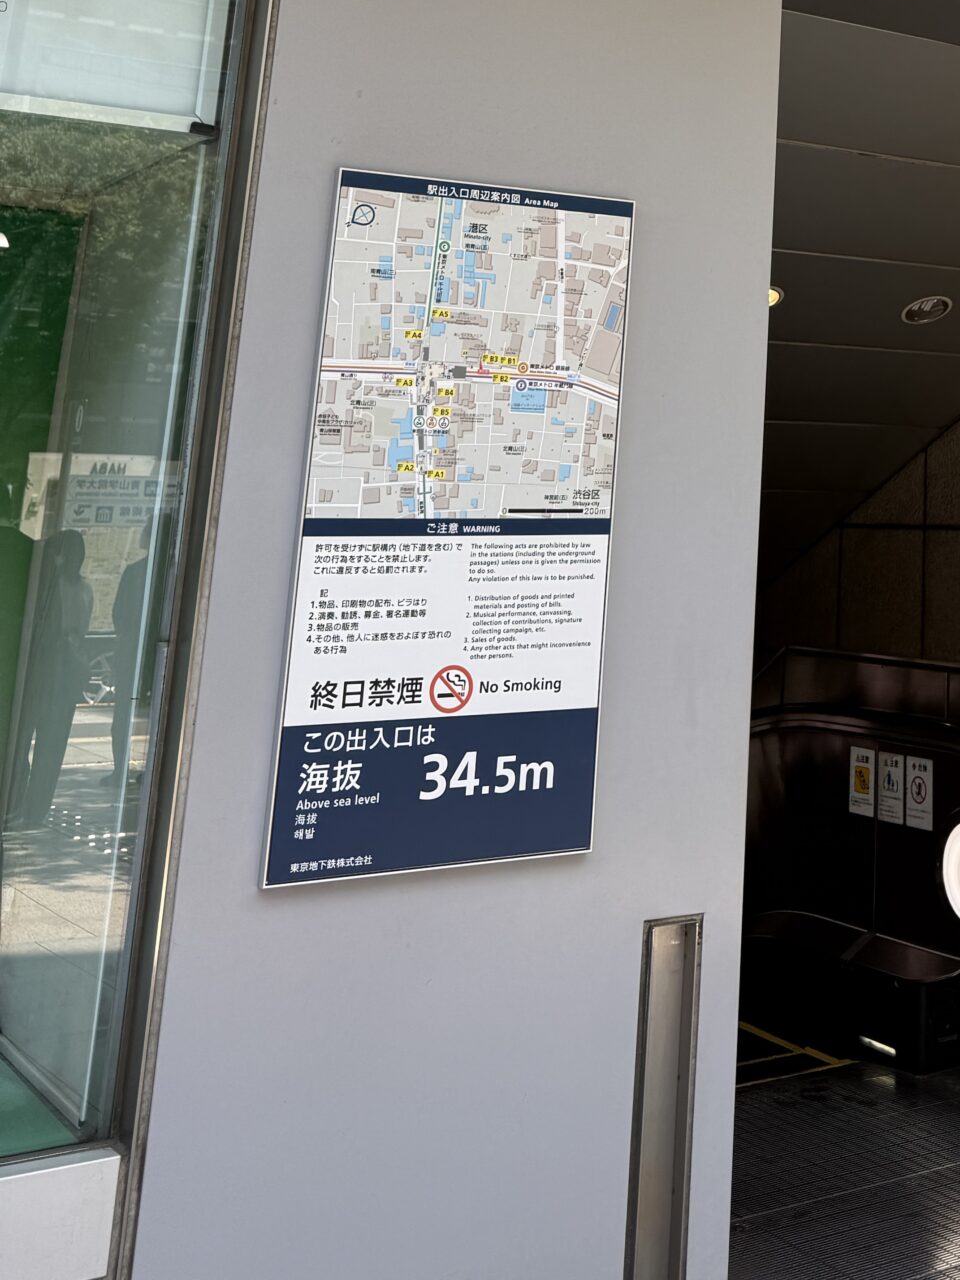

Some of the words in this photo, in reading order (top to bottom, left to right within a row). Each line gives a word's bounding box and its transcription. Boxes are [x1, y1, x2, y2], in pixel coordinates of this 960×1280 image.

[427, 184, 520, 204] 駅出入口周辺案内図
[543, 200, 558, 208] Map
[469, 222, 488, 234] 港区
[573, 490, 600, 500] 渋谷区
[427, 523, 458, 534] ご注意
[320, 589, 328, 597] 記
[314, 646, 347, 654] ある行為
[309, 676, 424, 710] 終日禁煙
[479, 680, 499, 694] No
[503, 678, 562, 694] Smoking
[303, 724, 436, 753] この出入口は
[297, 760, 363, 795] 海抜
[419, 751, 555, 800] 34.5m
[296, 800, 330, 811] Above
[334, 798, 351, 807] sea
[355, 793, 380, 805] level
[294, 828, 315, 840] 해발
[290, 856, 373, 873] 東京地下鉄株式会社
